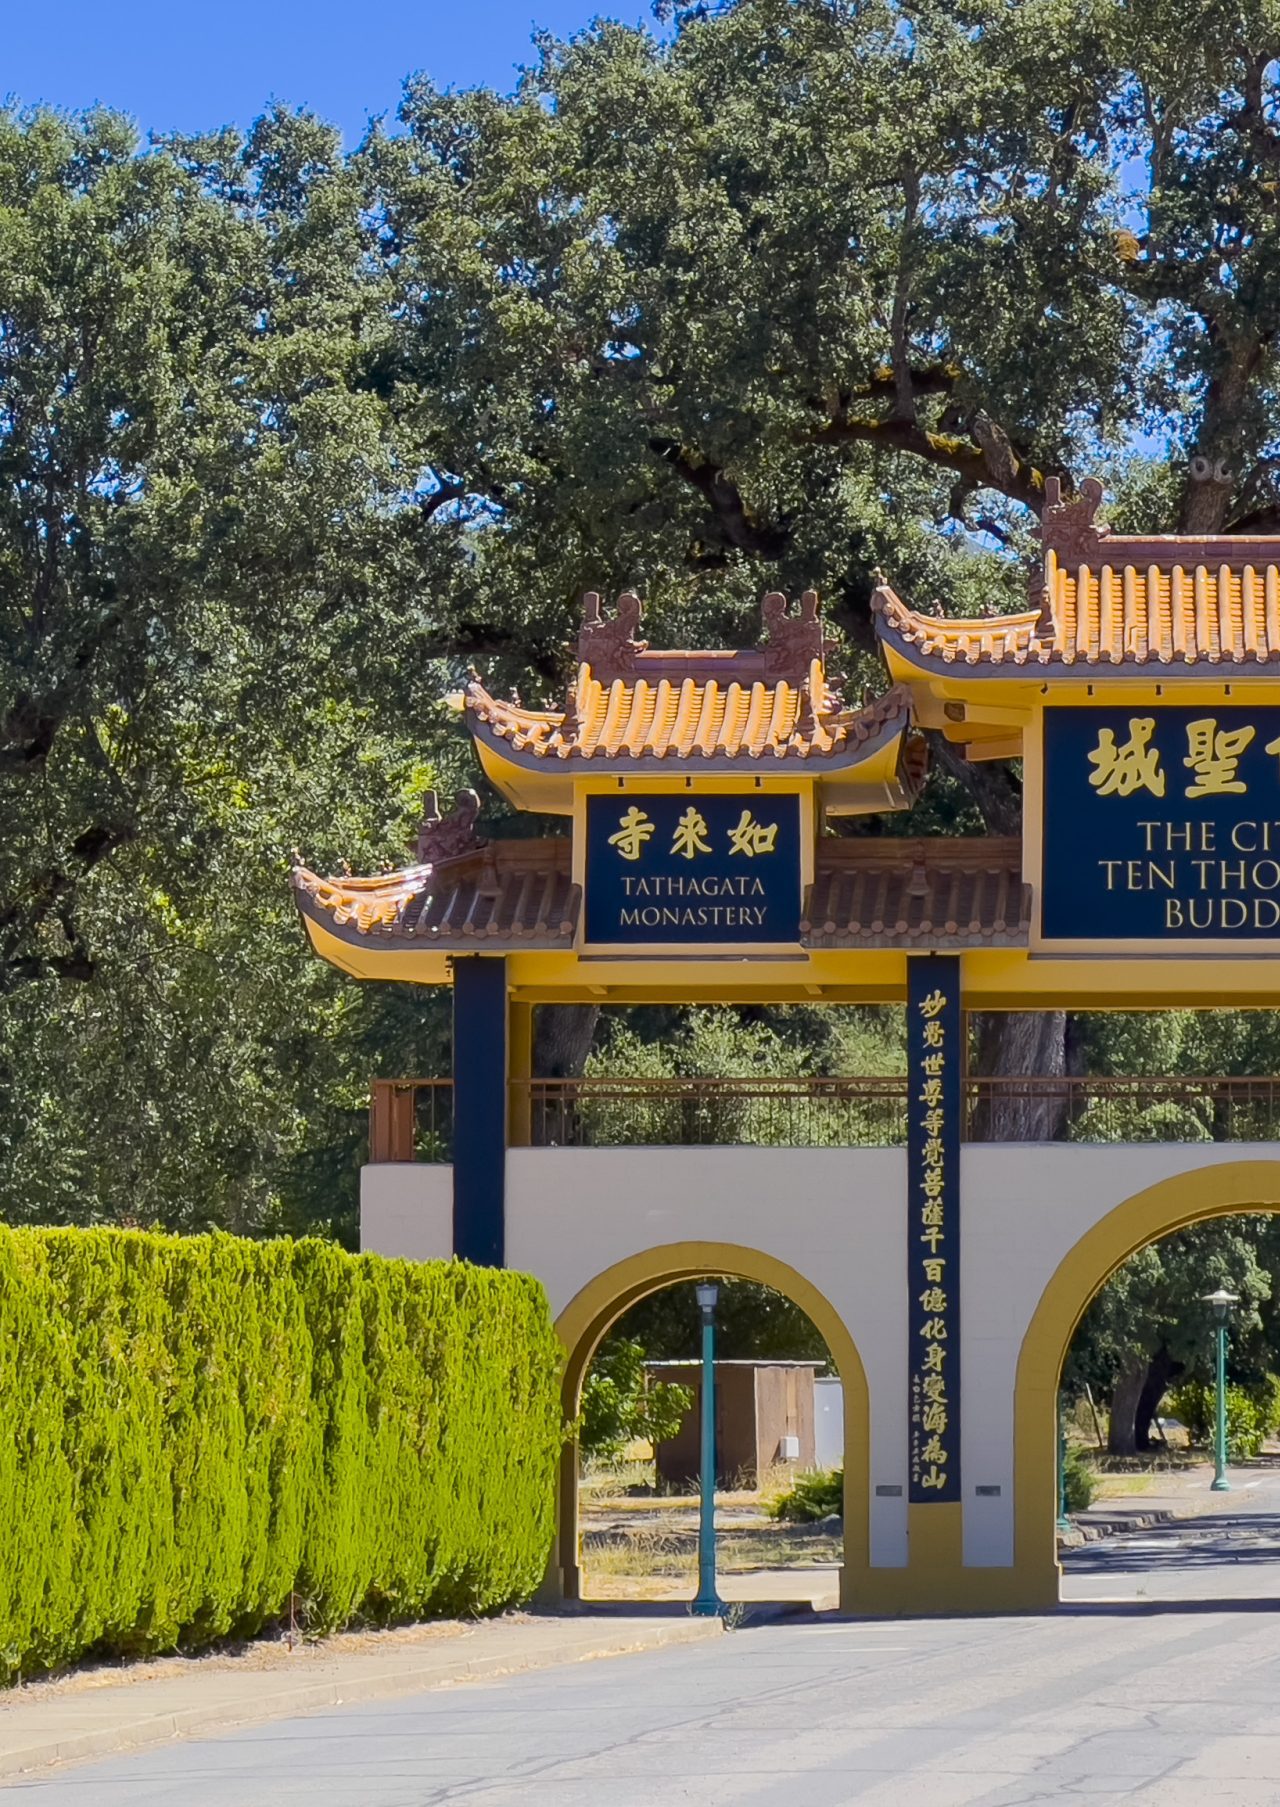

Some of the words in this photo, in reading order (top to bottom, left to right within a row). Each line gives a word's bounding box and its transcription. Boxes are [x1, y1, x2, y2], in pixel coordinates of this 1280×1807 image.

[1137, 821, 1216, 851] THE
[620, 876, 766, 896] TATHAGATA
[1098, 859, 1176, 890] TEN
[620, 906, 767, 926] MONASTERY
